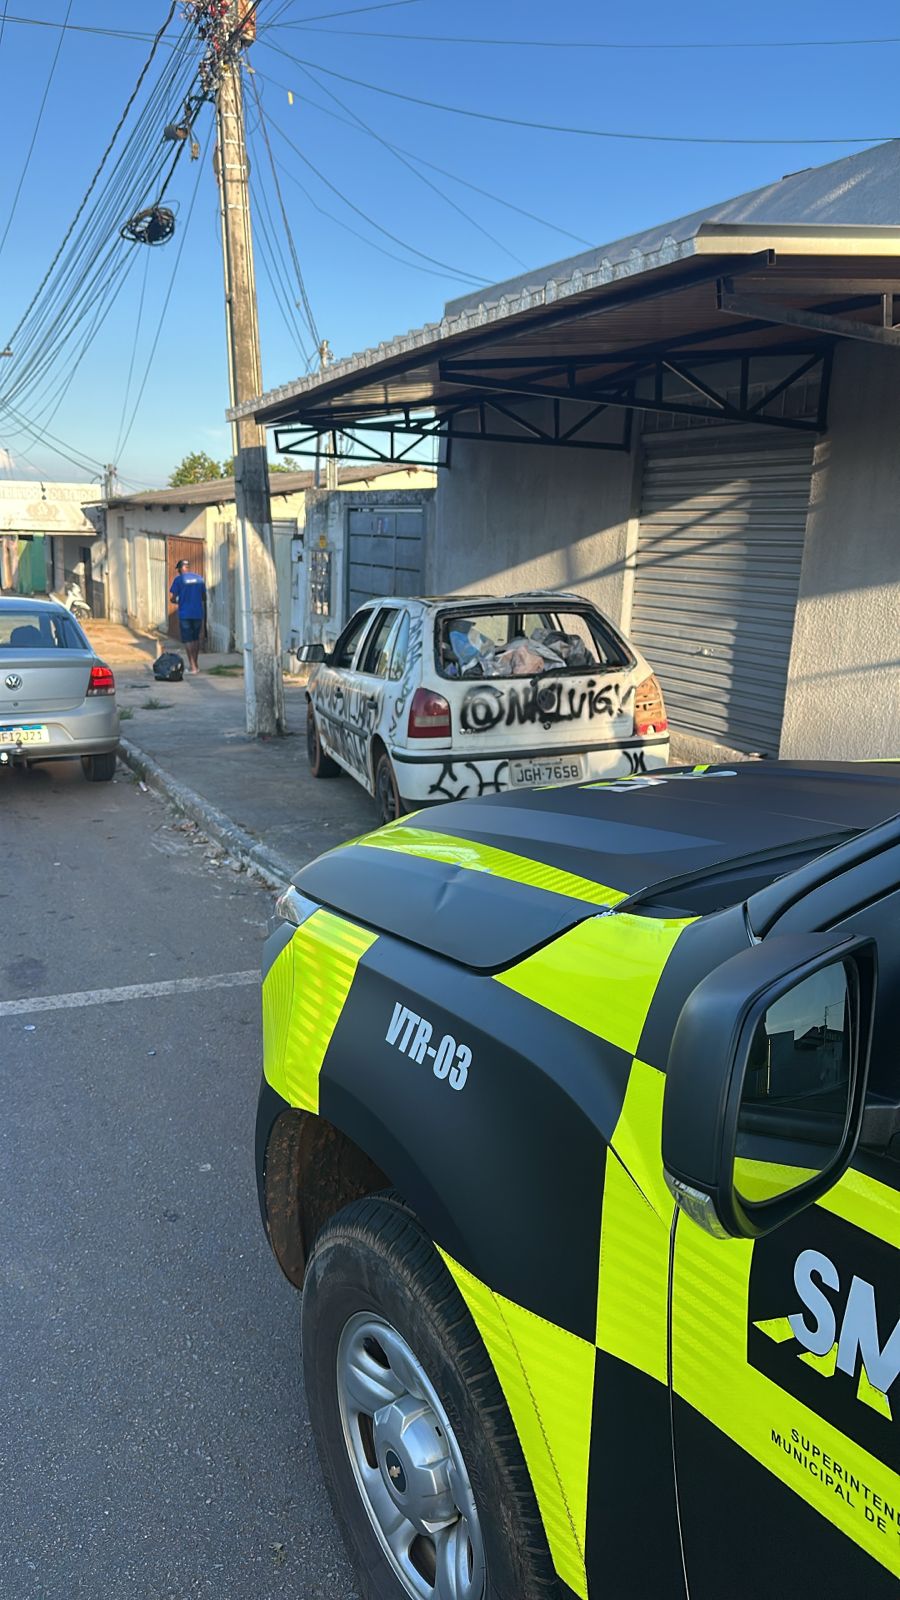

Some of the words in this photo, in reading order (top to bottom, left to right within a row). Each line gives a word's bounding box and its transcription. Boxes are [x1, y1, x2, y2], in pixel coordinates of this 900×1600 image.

[385, 1001, 473, 1091] VTR-03
[771, 1428, 856, 1509] MUNICIPAL
[864, 1505, 887, 1534] DE
